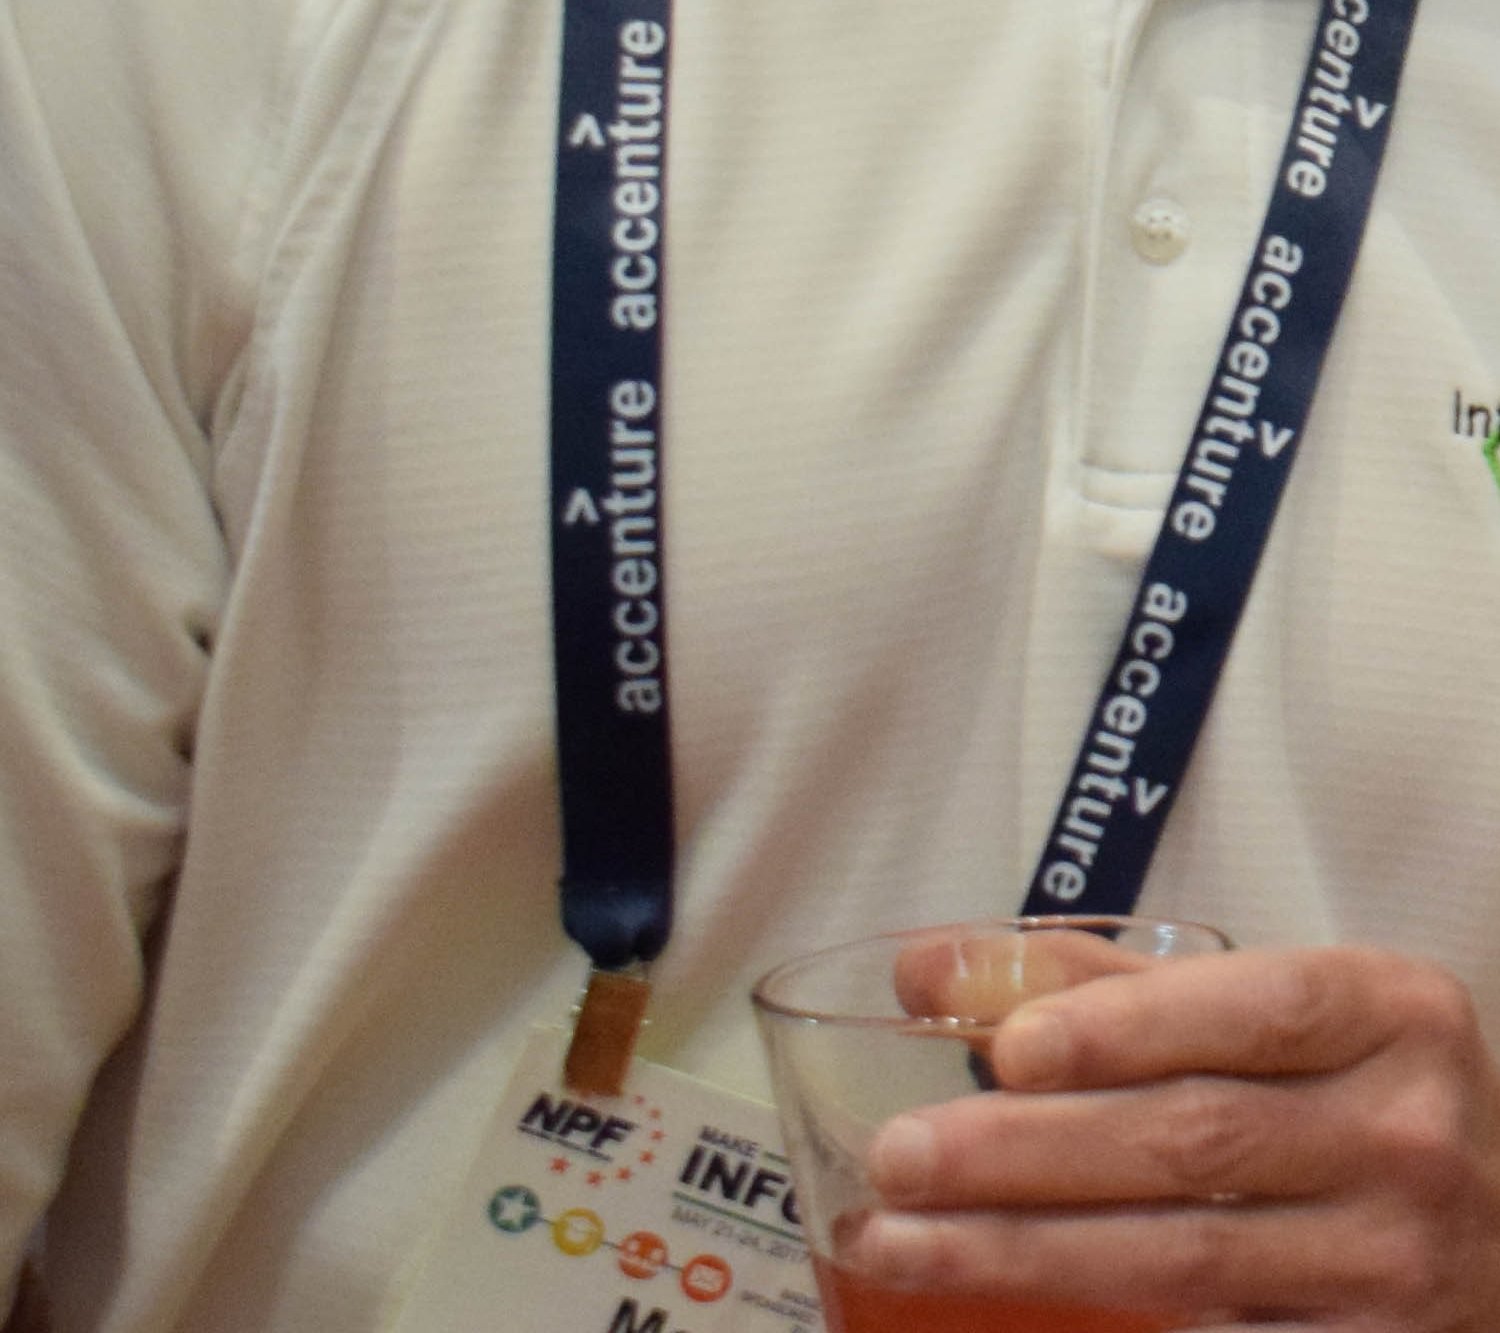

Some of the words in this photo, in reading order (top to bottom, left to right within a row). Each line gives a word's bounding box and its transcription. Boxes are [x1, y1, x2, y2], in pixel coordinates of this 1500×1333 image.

[609, 17, 665, 332] accenture
[1173, 233, 1304, 541] accenture
[600, 377, 658, 713] accenture
[1044, 584, 1188, 900] accenture
[518, 1093, 635, 1149] NPF
